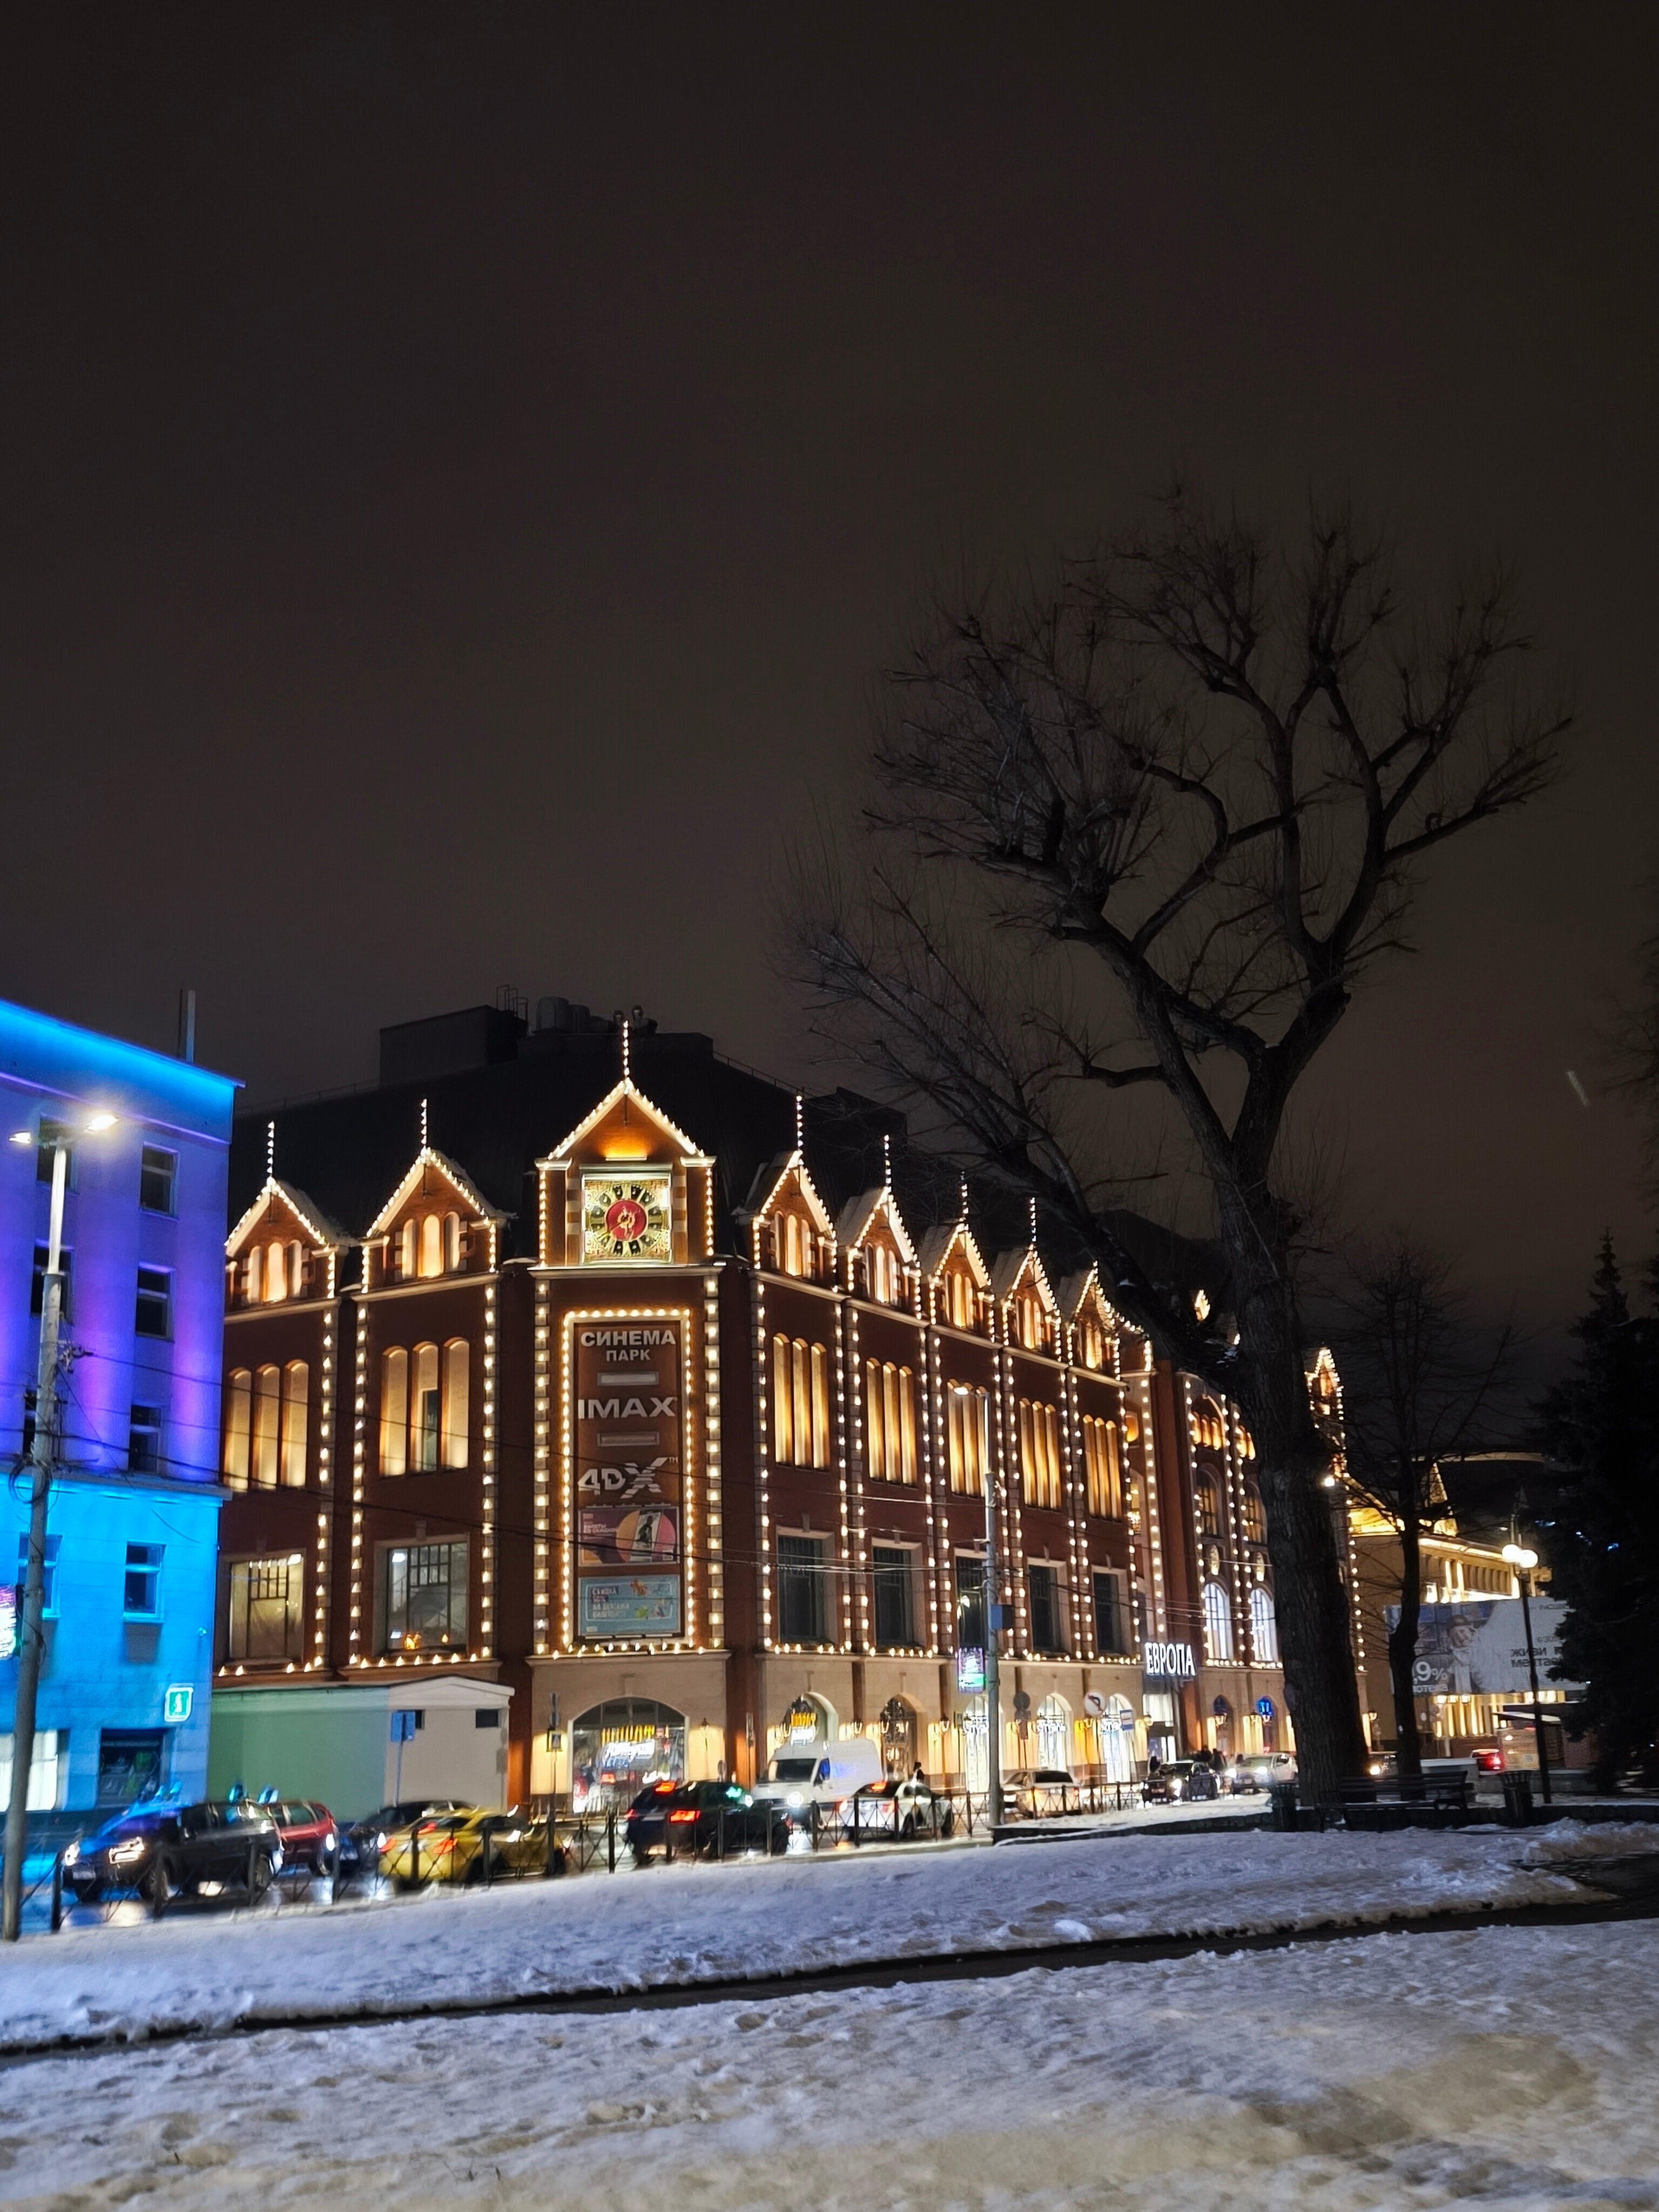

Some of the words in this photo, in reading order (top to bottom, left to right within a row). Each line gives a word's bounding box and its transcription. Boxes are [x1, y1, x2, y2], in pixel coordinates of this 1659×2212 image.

[581, 1330, 676, 1347] СИНЕМА
[606, 1349, 651, 1361] ПАРК
[578, 1397, 676, 1419] IMAX
[1145, 1642, 1196, 1676] ЕВРОПА
